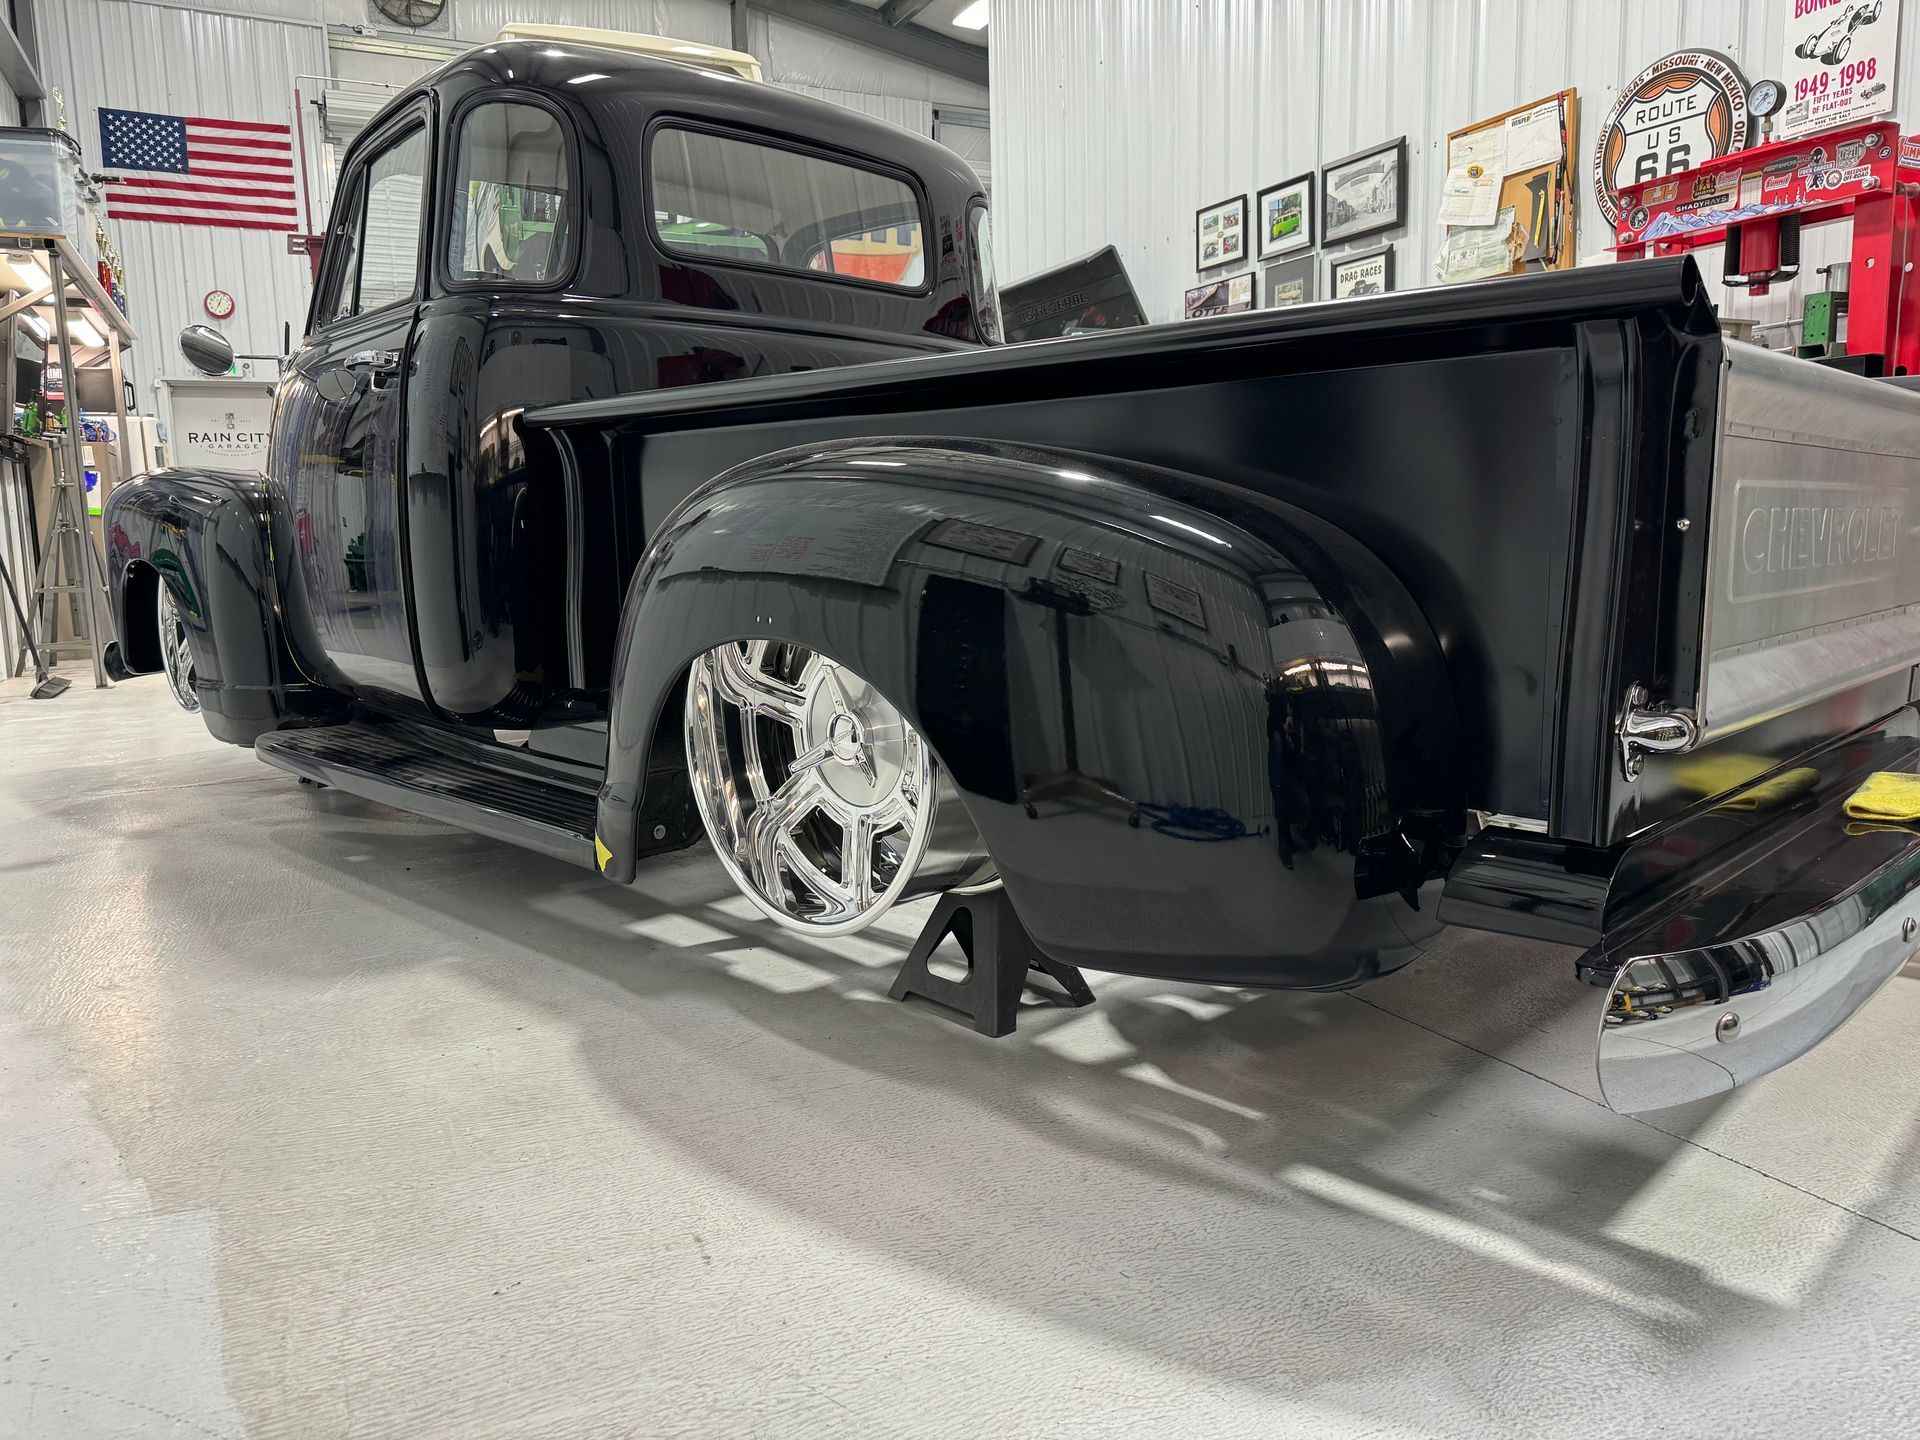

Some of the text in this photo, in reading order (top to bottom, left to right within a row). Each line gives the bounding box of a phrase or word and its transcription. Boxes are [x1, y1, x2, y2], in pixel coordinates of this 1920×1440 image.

[1652, 54, 1698, 76] MISSOURI
[1704, 57, 1745, 112] NEW MEXICO
[1812, 98, 1852, 115] OF FLAT-OUT
[1813, 87, 1853, 105] FIFTY YEARS
[1635, 94, 1697, 126] ROUTE
[1594, 122, 1612, 170] ILLINOIS
[1634, 144, 1692, 184] 66
[1844, 166, 1869, 176] FREEDOM
[1843, 171, 1869, 182] OFF-ROAD
[1340, 270, 1358, 284] DRAG
[1360, 264, 1382, 279] RACES
[188, 432, 231, 443] RAIN
[1742, 506, 1904, 574] CHEVROLET
